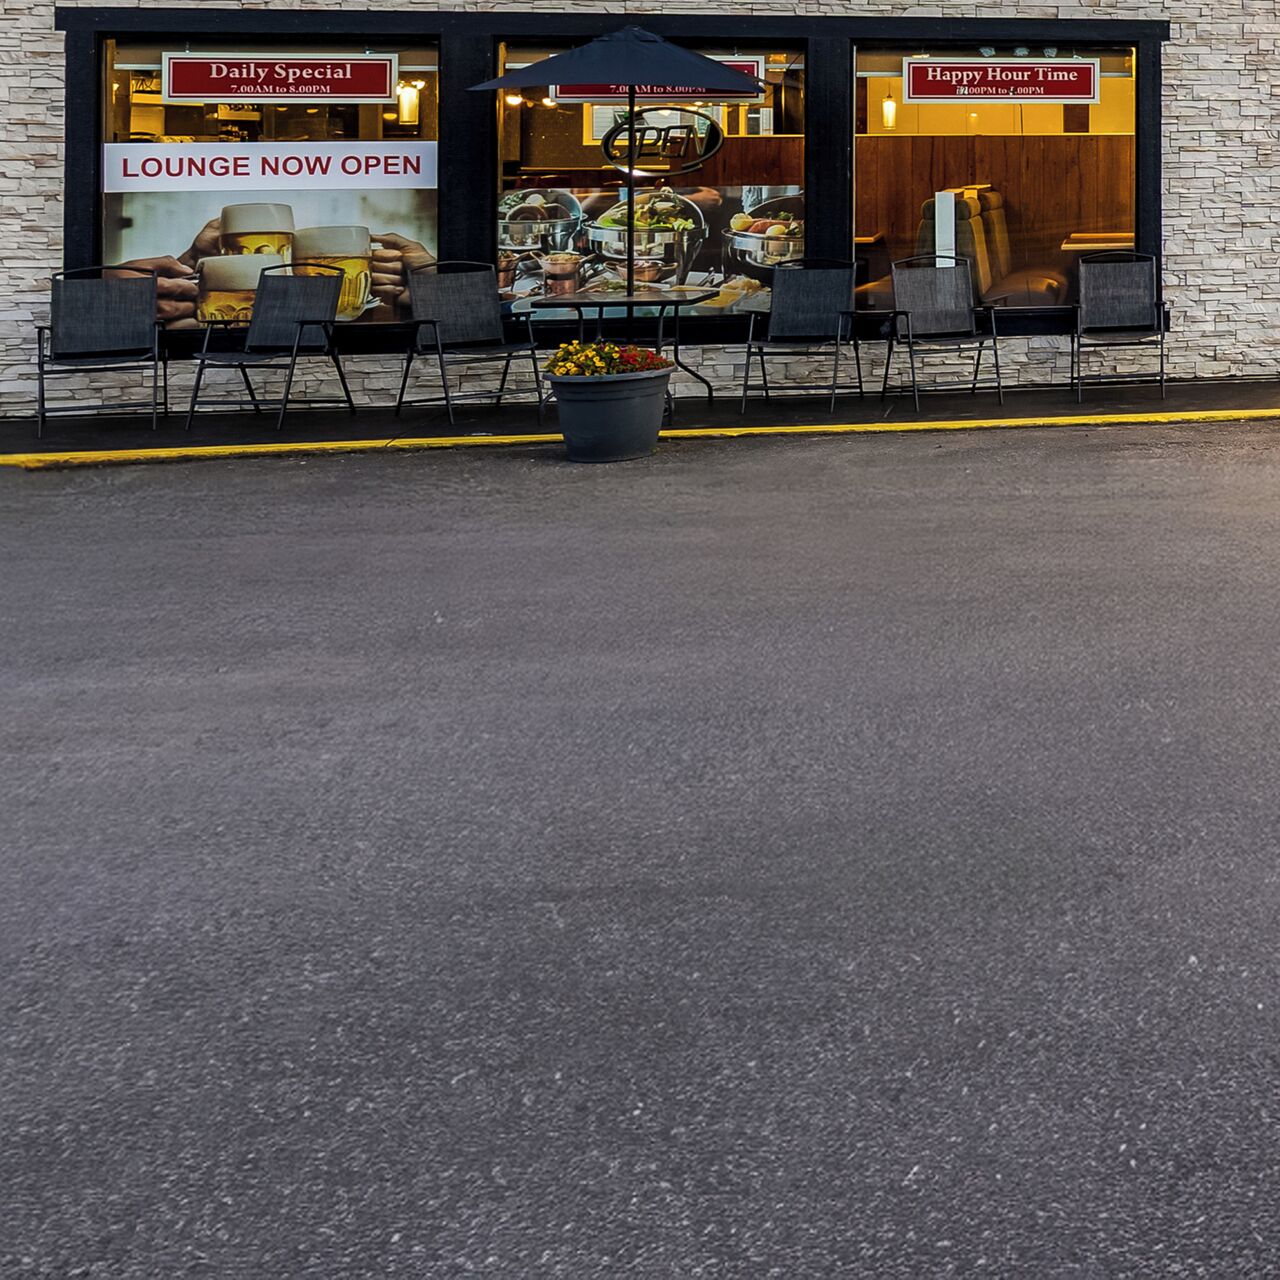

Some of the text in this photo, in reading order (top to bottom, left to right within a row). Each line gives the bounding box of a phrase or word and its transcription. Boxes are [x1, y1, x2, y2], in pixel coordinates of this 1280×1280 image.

[209, 63, 352, 83] Daily Special
[926, 67, 1078, 85] Happy Hour Time
[230, 85, 331, 93] 7.00AM to 8.00PM
[653, 85, 664, 93] to
[998, 86, 1008, 94] to
[122, 155, 421, 178] LOUNGE NOW OPEN
